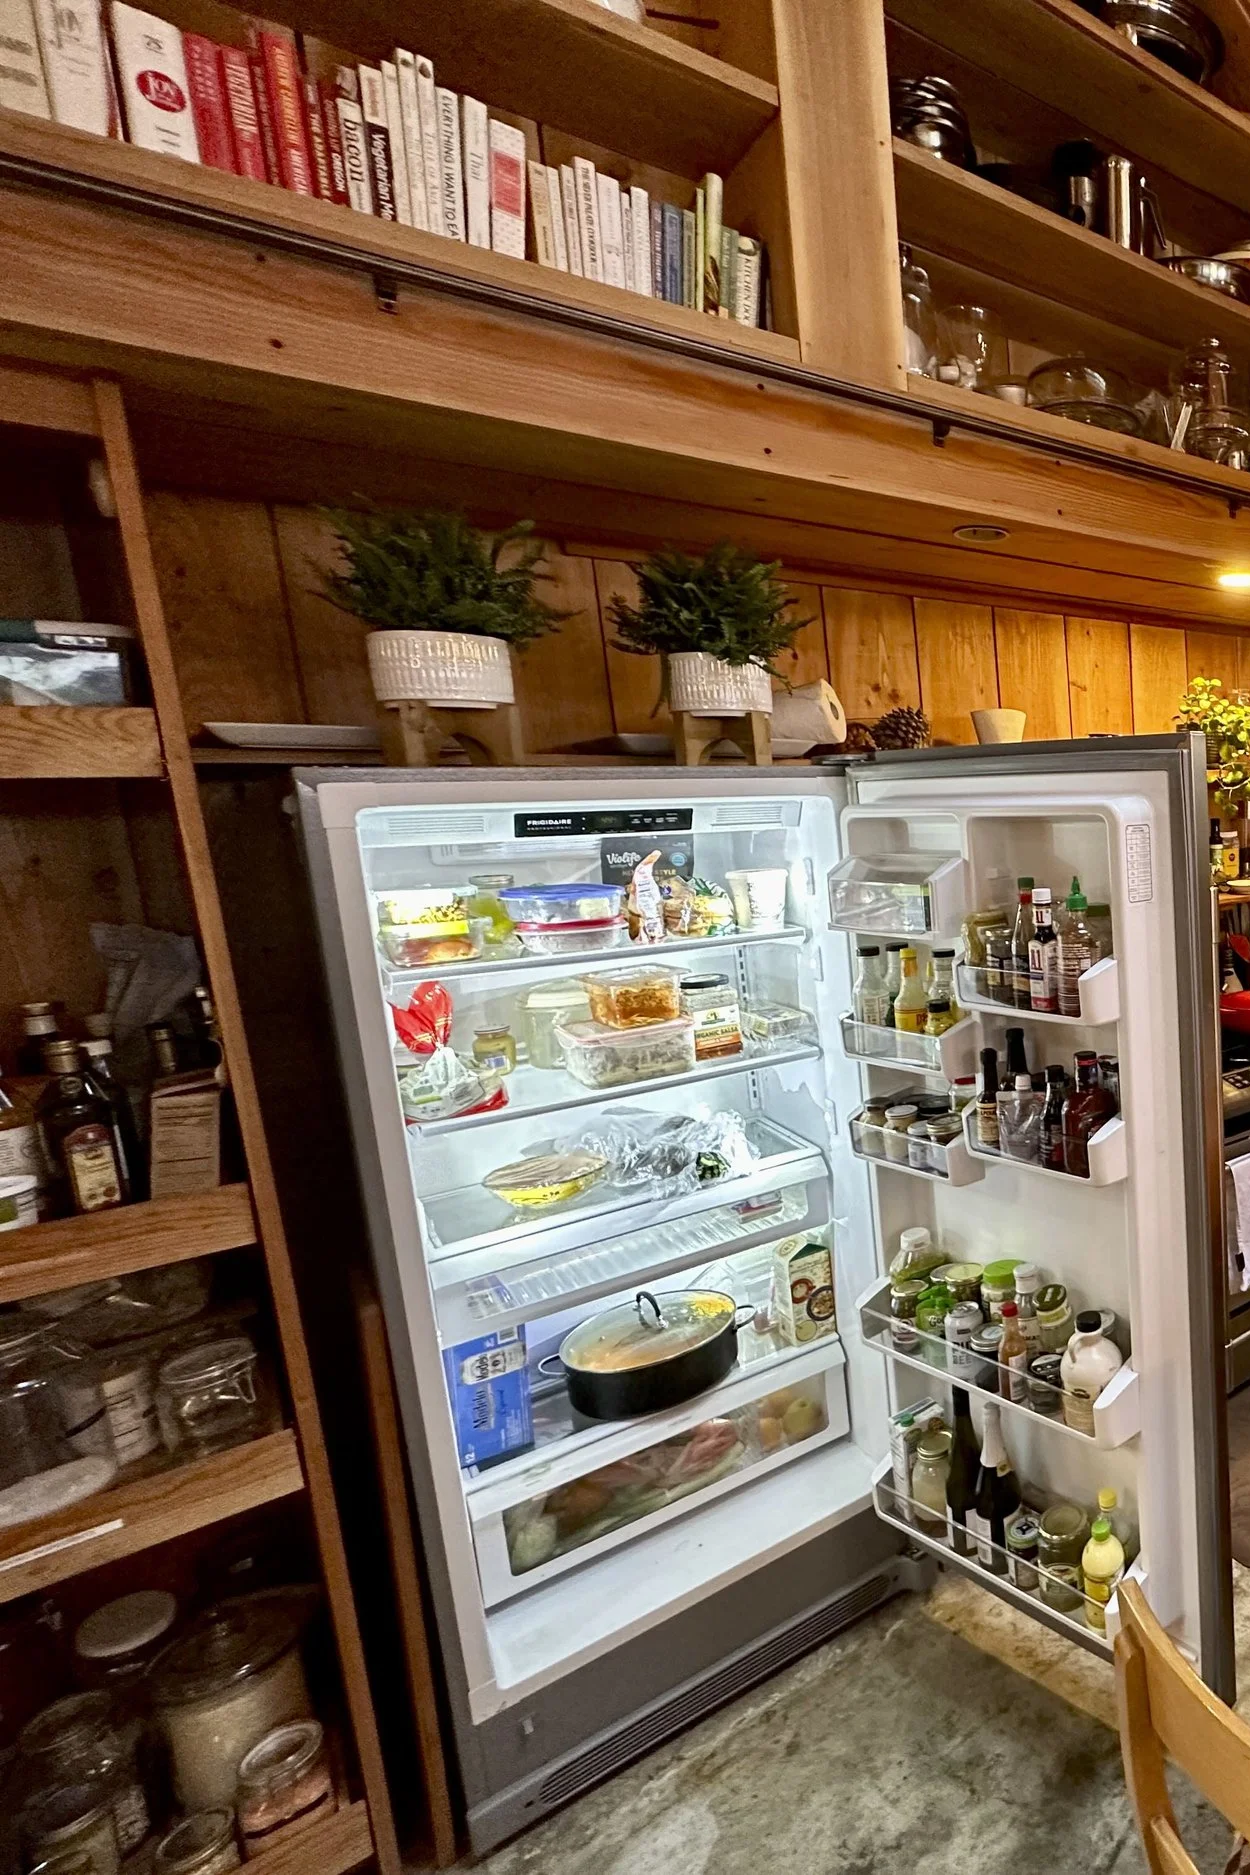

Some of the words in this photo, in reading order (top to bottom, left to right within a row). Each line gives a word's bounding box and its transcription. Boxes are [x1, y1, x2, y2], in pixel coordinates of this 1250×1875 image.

[442, 95, 456, 164] EVERYTHING
[344, 118, 365, 183] bacon
[371, 133, 391, 200] Vegetarian
[331, 152, 346, 192] OREGON
[443, 171, 457, 205] WANT
[446, 205, 457, 225] TO
[606, 852, 641, 866] Violife
[721, 1026, 739, 1035] SALSA
[472, 1390, 488, 1429] Modelo
